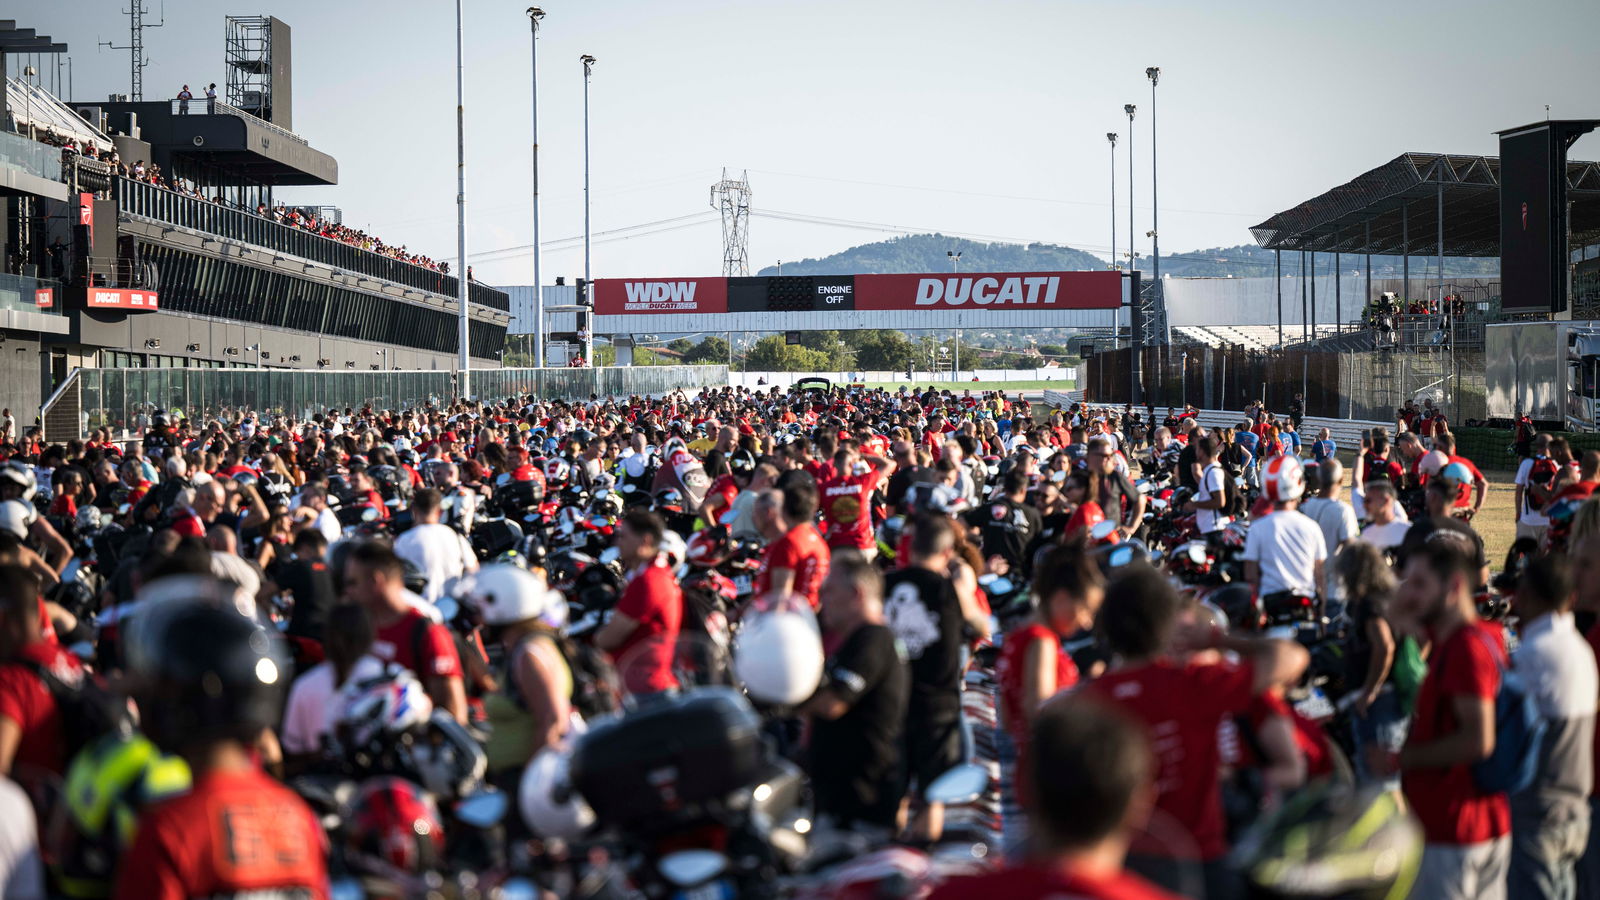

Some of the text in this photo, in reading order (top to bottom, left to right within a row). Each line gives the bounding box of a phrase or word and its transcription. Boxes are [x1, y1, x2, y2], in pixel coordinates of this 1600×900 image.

[624, 281, 697, 302] WDW
[818, 285, 852, 294] ENGINE
[915, 277, 1060, 305] DUCATI
[95, 292, 120, 304] DUCATI
[825, 295, 844, 304] OFF
